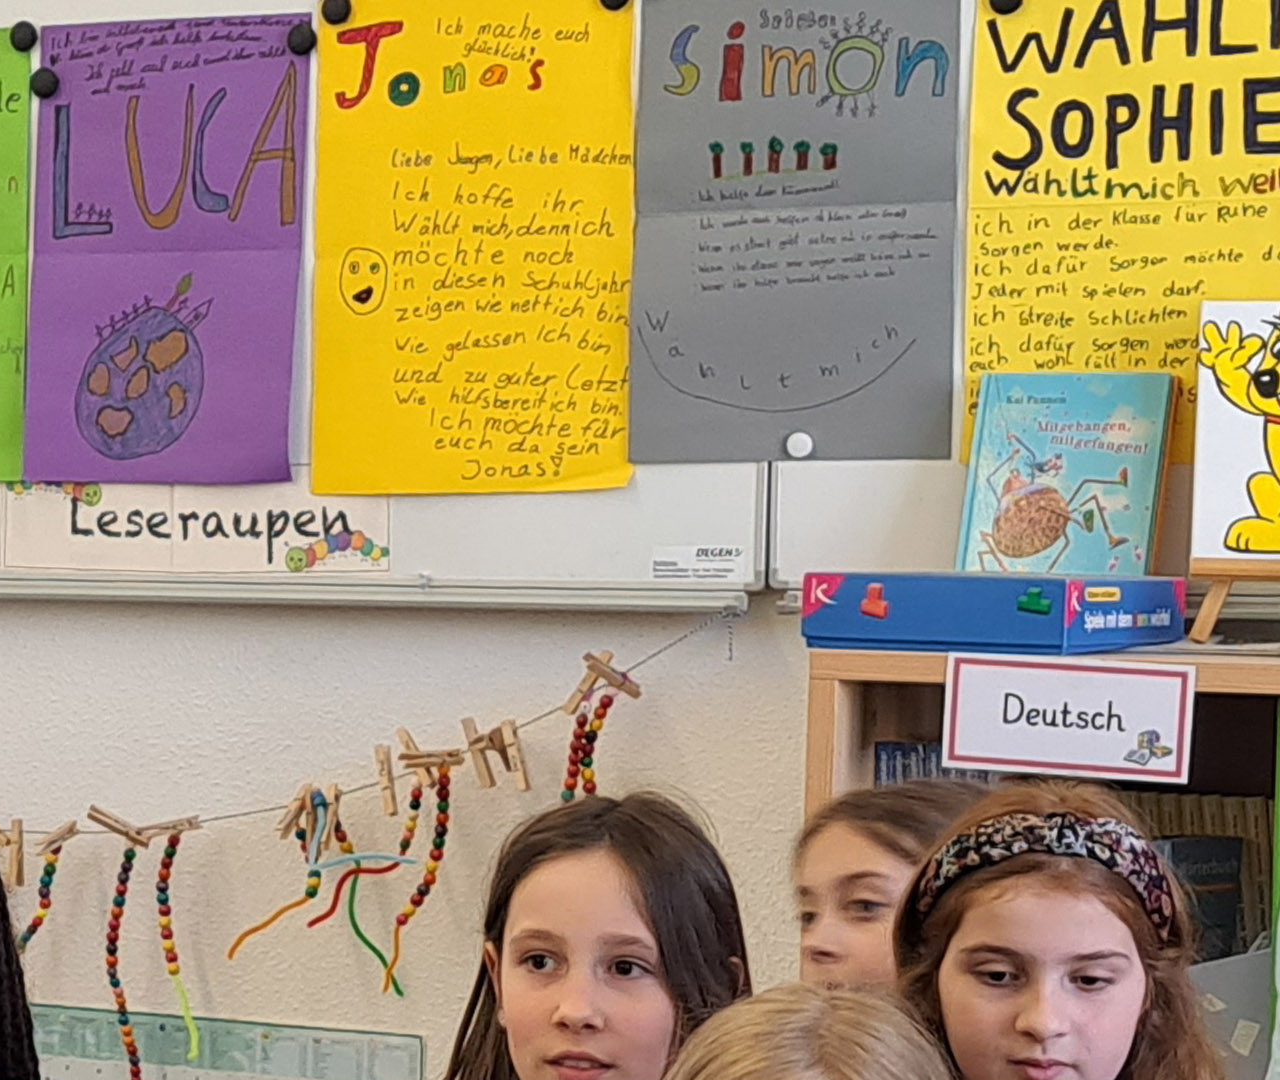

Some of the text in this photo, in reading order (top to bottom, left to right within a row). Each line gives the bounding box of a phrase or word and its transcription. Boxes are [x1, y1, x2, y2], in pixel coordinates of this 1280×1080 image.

[436, 12, 590, 43] Ich mache euch
[335, 21, 545, 109] Jonas
[53, 60, 297, 239] LUCA
[569, 143, 633, 166] Mädchen
[393, 176, 430, 202] Ich
[985, 167, 1099, 197] Wählt
[1105, 172, 1200, 200] mich
[974, 205, 1208, 237] ich in der Klasse für
[393, 241, 505, 268] möchte
[974, 258, 1012, 277] ich
[1026, 255, 1088, 276] dafür
[394, 274, 415, 291] in
[971, 282, 1024, 301] Jeder
[1035, 282, 1069, 298] mit
[395, 296, 466, 322] zeigen
[972, 305, 1006, 328] ich
[577, 335, 612, 356] bin
[969, 331, 1076, 357] ich dafür
[1034, 350, 1193, 370] wohl der
[393, 361, 558, 389] und zu guter
[430, 407, 626, 440] Ich möchte für
[435, 430, 600, 456] euch da sein
[71, 500, 353, 565] Leseraupen
[1002, 692, 1126, 734] Deutsch
